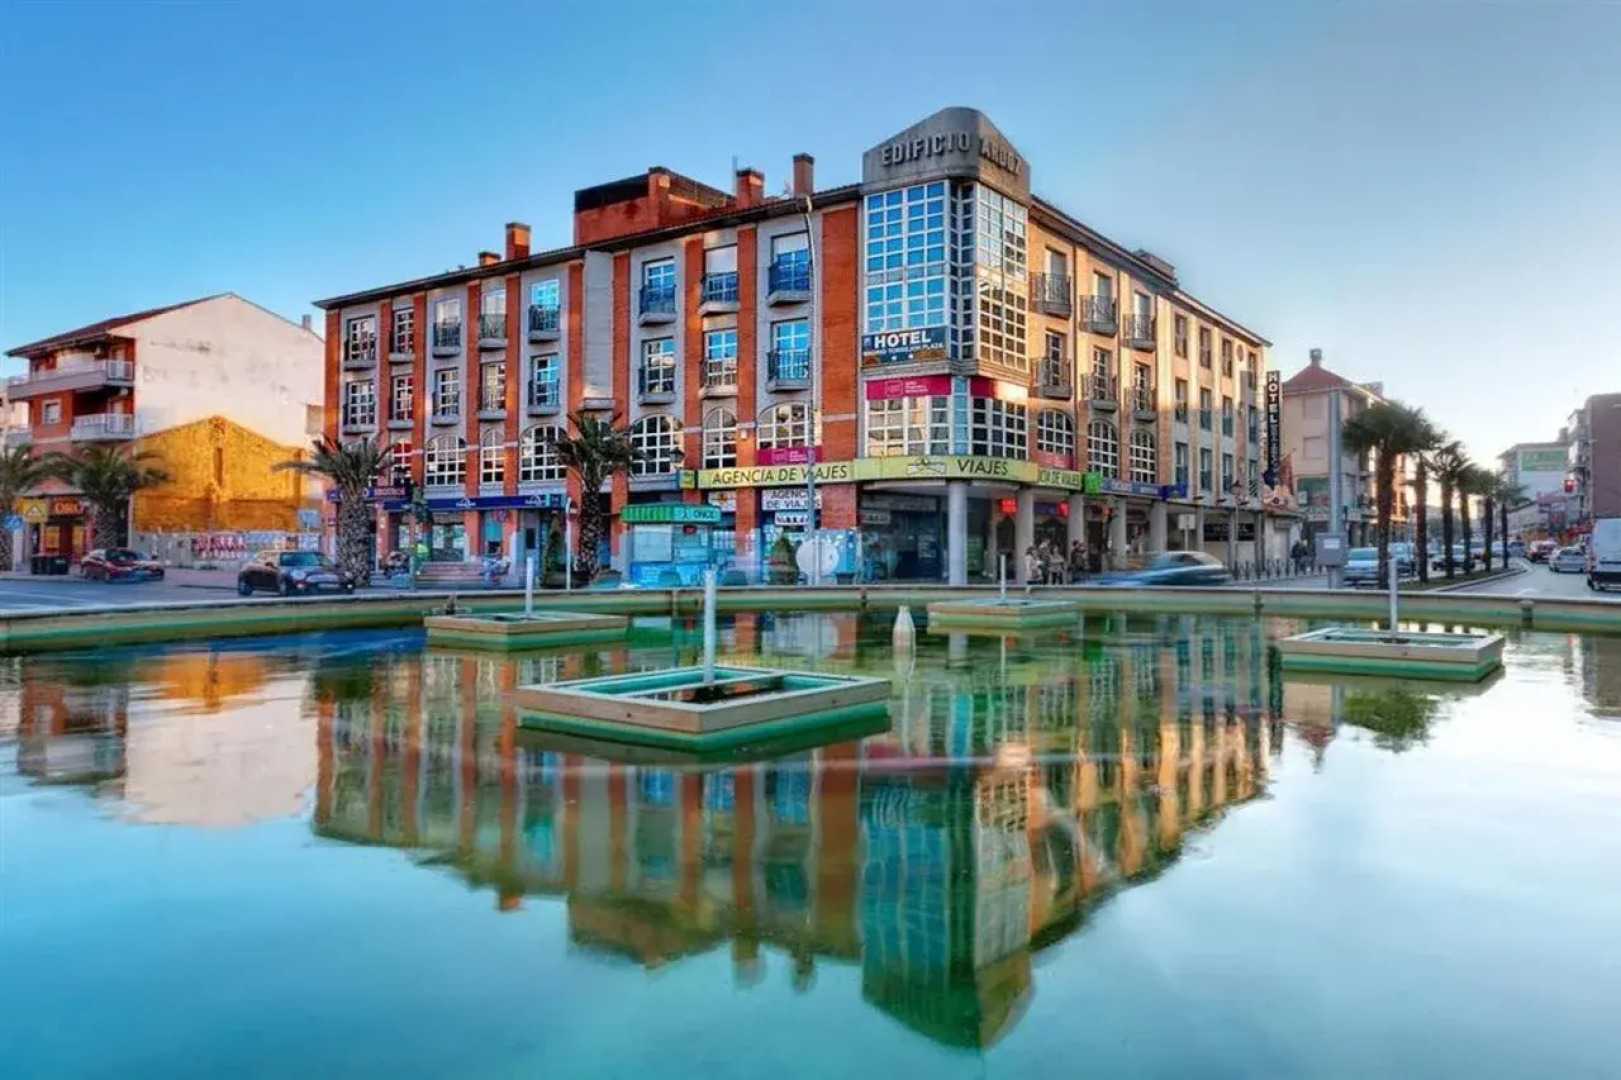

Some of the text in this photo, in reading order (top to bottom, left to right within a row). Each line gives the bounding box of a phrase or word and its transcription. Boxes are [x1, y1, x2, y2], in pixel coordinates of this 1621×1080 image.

[882, 132, 970, 166] EDIFICIO
[874, 330, 931, 348] HOTEL
[1268, 372, 1279, 423] HOTEL
[712, 465, 848, 485] AGENCIA DE VAJES
[957, 459, 1008, 476] VIAJES
